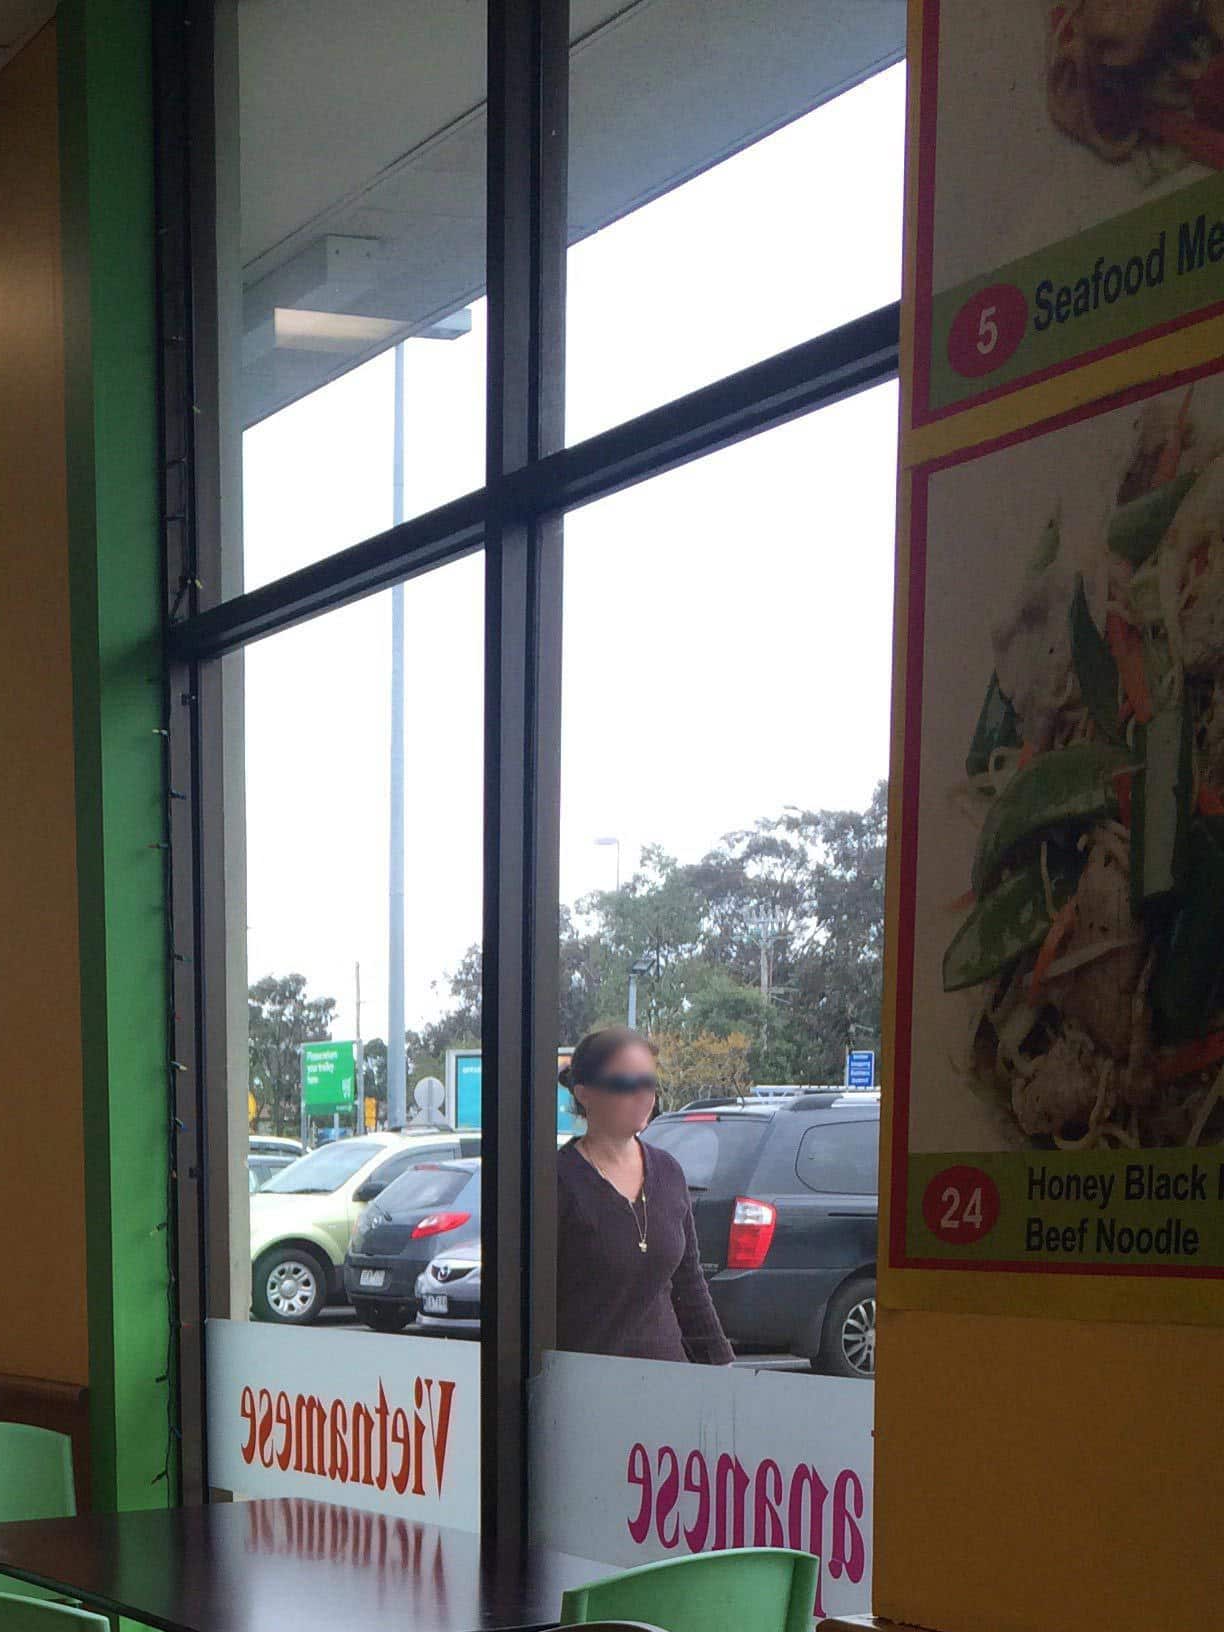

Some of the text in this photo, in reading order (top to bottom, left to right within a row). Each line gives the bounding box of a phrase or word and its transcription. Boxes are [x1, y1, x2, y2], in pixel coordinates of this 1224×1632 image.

[977, 306, 999, 355] 5
[1034, 230, 1167, 332] Seafood
[940, 1186, 983, 1230] 24
[1028, 1166, 1115, 1209] Honey
[1126, 1164, 1208, 1201] Black
[1026, 1217, 1200, 1255] Beef Noodle
